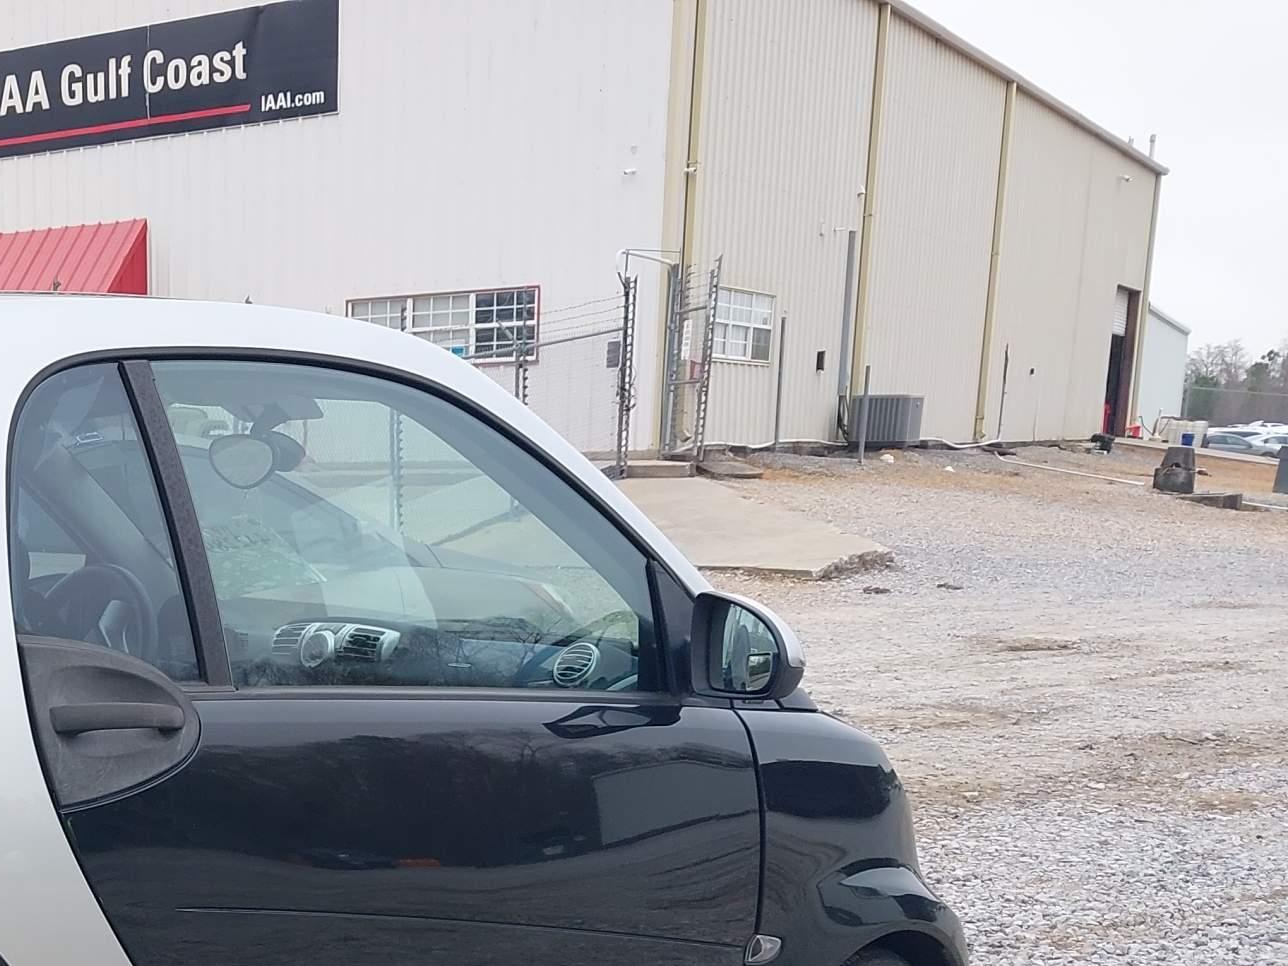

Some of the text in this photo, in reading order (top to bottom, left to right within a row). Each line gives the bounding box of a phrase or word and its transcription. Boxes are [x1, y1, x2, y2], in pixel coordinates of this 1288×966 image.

[60, 55, 132, 106] Gulf
[143, 40, 247, 93] Coast
[261, 91, 325, 112] IAAI.com
